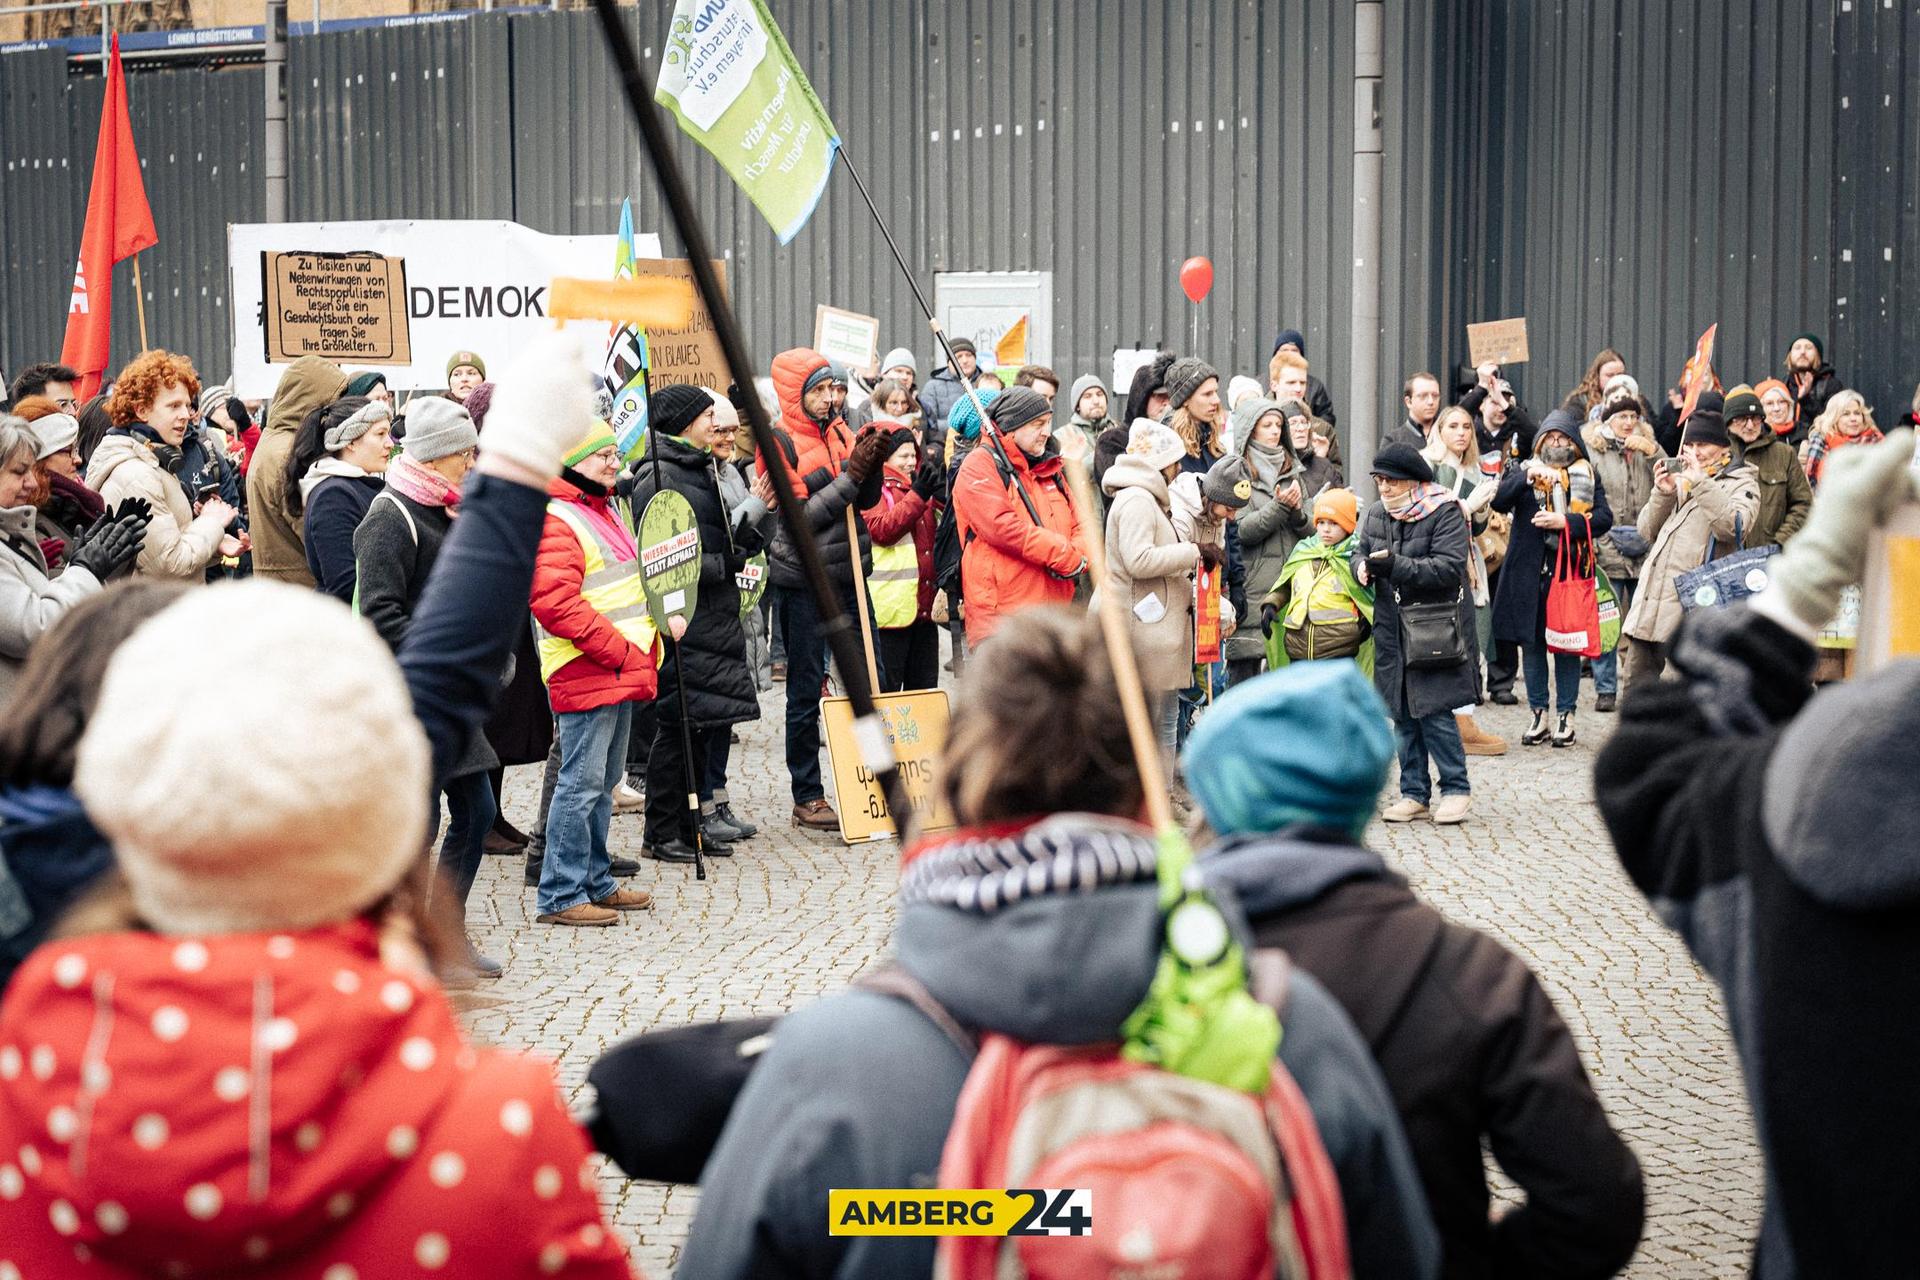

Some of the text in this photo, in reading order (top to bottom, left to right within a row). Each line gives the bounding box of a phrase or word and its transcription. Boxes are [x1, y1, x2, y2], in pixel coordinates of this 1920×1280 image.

[298, 258, 371, 272] Zu Risiken und
[289, 272, 385, 290] Nebenwirkungen von
[296, 285, 385, 302] Rechtspopulisten
[410, 285, 548, 319] DEMOK
[308, 299, 369, 311] lesen Sie ein
[284, 310, 380, 325] Geschichtsbuch oder
[319, 324, 366, 342] fragen Sie
[302, 338, 320, 351] Ihre
[665, 344, 701, 367] BLAUES
[649, 371, 717, 392] EUTSCHLAND
[642, 544, 669, 562] WIESEN
[676, 532, 696, 546] WALD
[645, 544, 697, 577] STATT ASPHALT
[741, 567, 759, 577] LD
